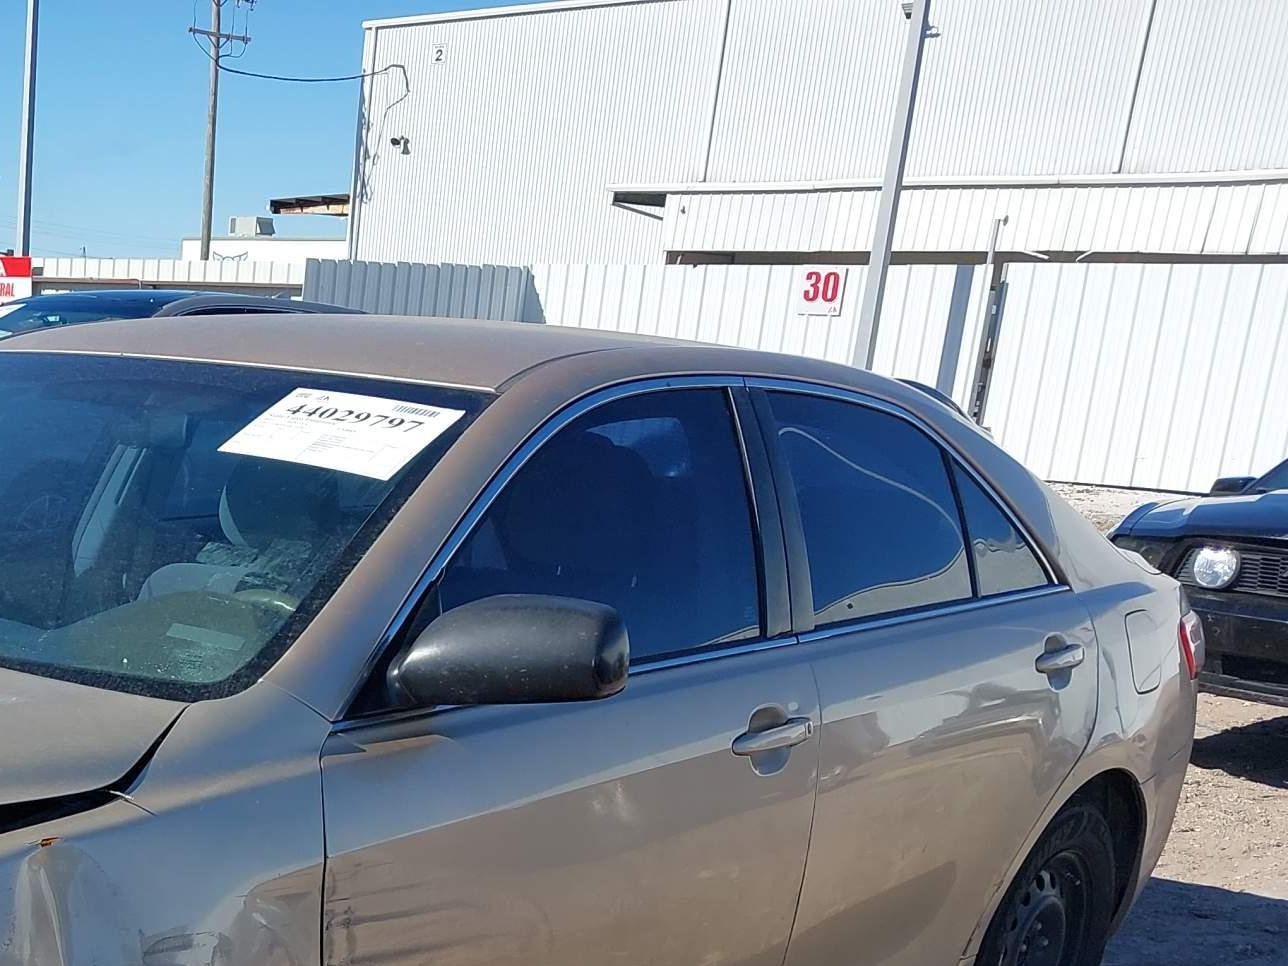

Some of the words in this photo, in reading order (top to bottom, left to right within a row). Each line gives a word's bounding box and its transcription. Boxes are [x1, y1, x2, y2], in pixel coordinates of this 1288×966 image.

[435, 49, 442, 61] 2
[803, 271, 840, 302] 30
[287, 403, 425, 432] 44029797
